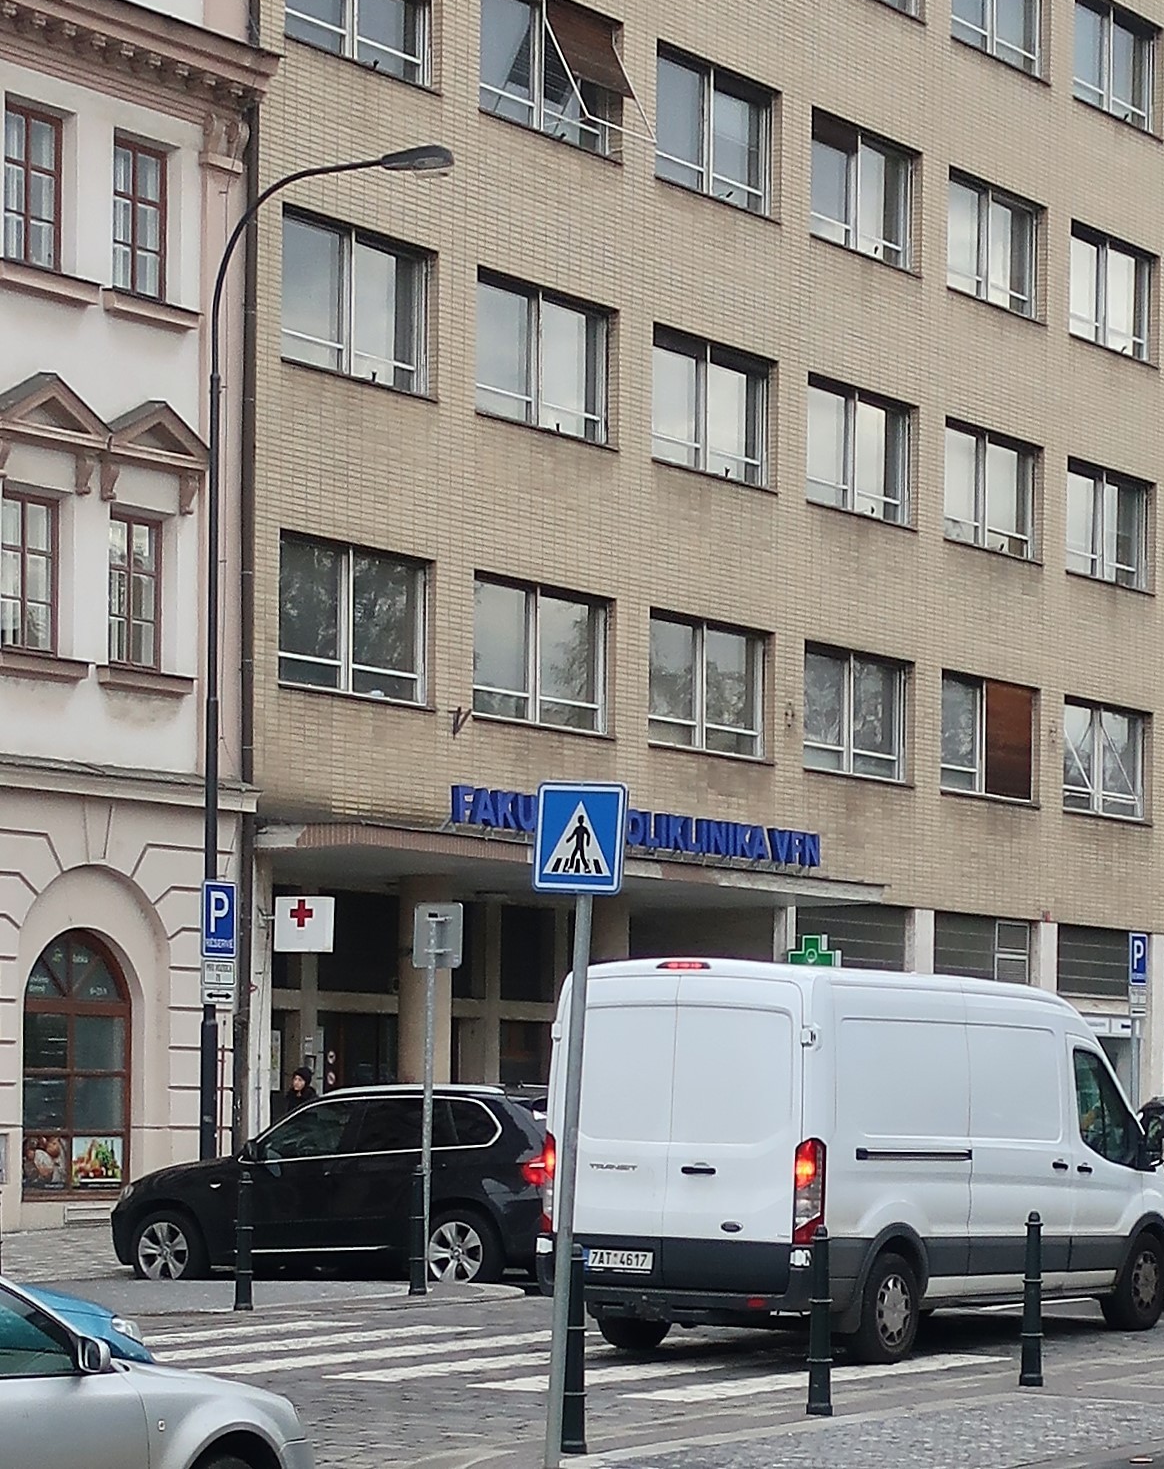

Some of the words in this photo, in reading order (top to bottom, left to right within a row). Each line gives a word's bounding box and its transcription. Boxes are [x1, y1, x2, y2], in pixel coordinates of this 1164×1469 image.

[450, 785, 539, 833] FAKU
[625, 809, 770, 861] OLIKLINIKA
[767, 828, 820, 867] VFN
[210, 891, 229, 933] P
[1134, 940, 1144, 969] P
[591, 1250, 613, 1265] 7AT
[619, 1251, 648, 1268] 4617
